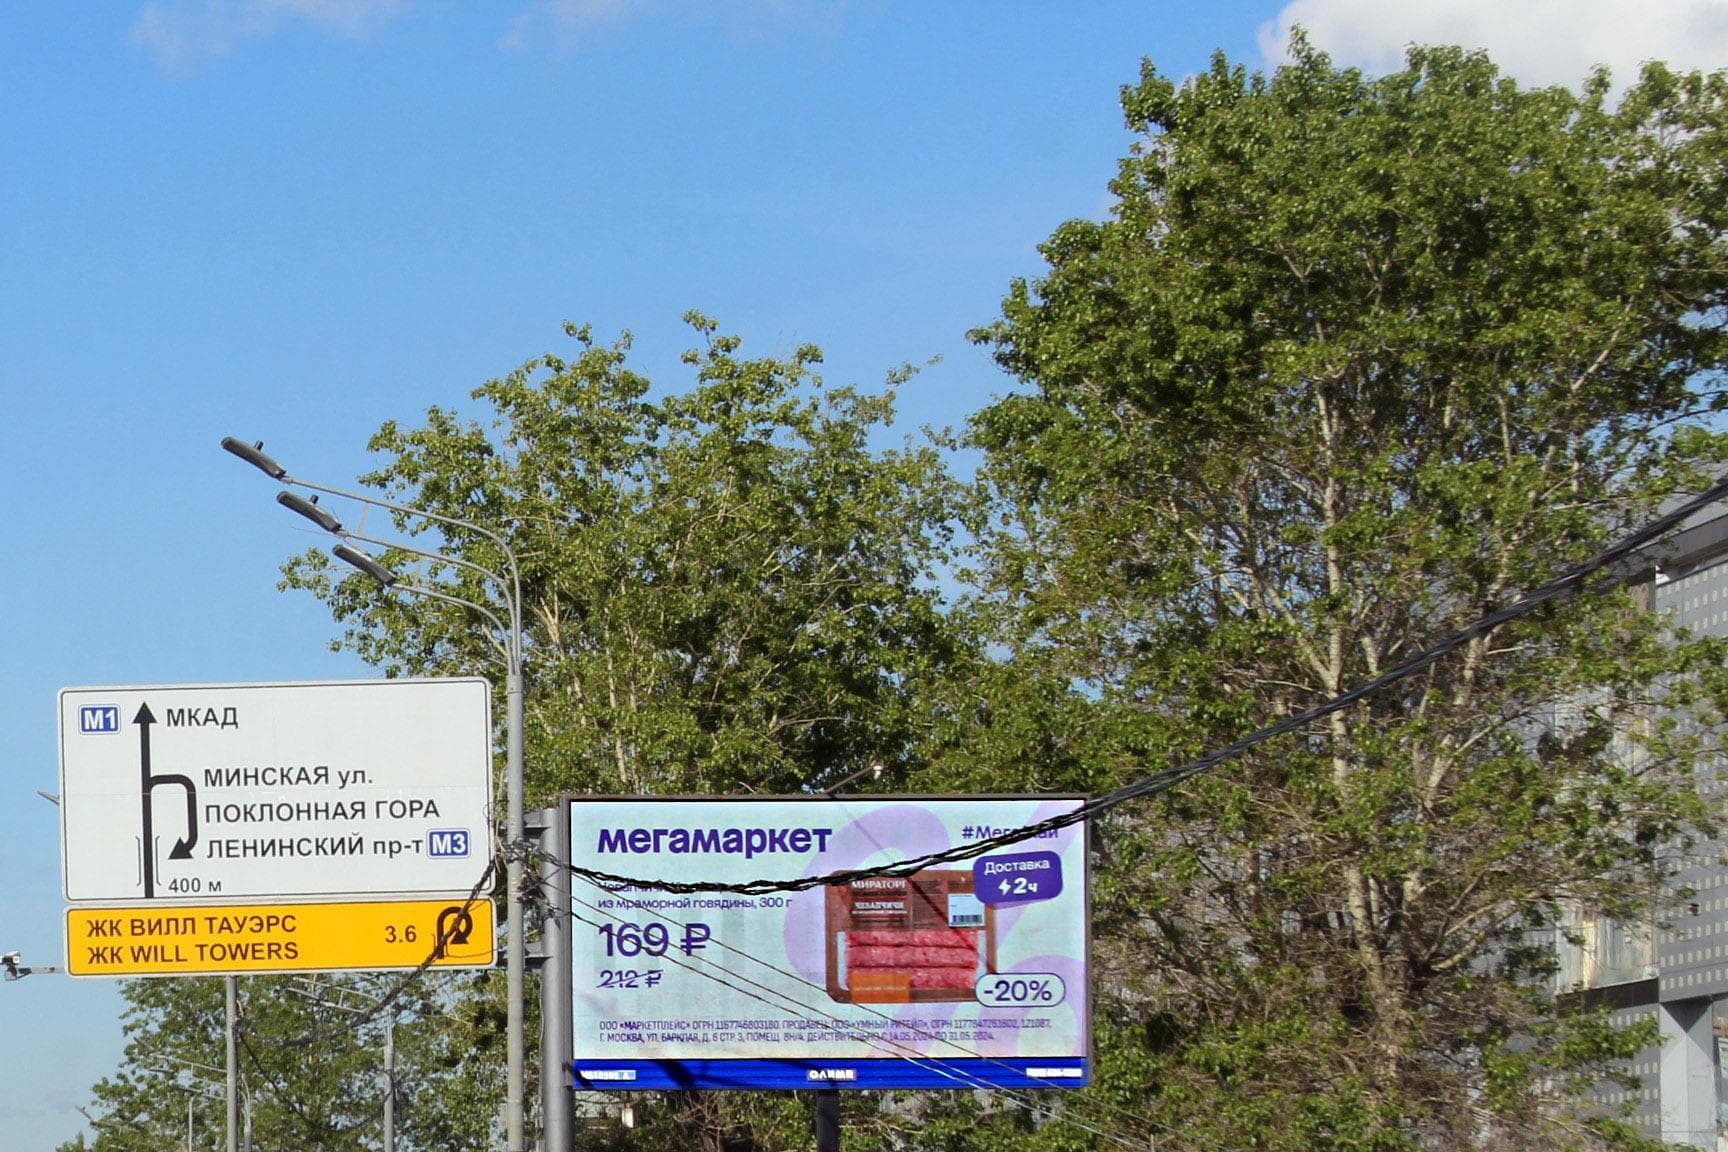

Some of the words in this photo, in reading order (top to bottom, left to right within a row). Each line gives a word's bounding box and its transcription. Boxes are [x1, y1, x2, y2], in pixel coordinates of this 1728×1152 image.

[84, 709, 117, 730] М1
[166, 707, 239, 730] МКАД
[204, 766, 329, 788] МИНСКАЯ
[337, 769, 373, 790] ул.
[205, 801, 366, 824] ПОКЛОННАЯ
[375, 799, 440, 820] ГОРА
[206, 832, 365, 859] ЛЕНИНСКИЙ
[373, 840, 423, 859] пр-т
[431, 832, 468, 854] М3
[597, 827, 833, 859] мегамаркет
[983, 858, 1051, 876] Доставка
[168, 876, 201, 894] 400
[208, 881, 222, 892] м
[598, 898, 614, 909] из
[616, 896, 691, 910] мраморной
[693, 897, 758, 911] говядины,
[759, 896, 784, 909] 300
[86, 918, 122, 938] ЖК
[129, 917, 196, 937] ВИЛЛ
[204, 914, 298, 936] ТАУЭРС
[384, 924, 417, 943] 3.6
[599, 922, 669, 957] 169
[87, 945, 123, 964] ЖК
[129, 944, 187, 963] WILL
[194, 941, 299, 962] TOWERS
[983, 979, 1052, 1002] -20%
